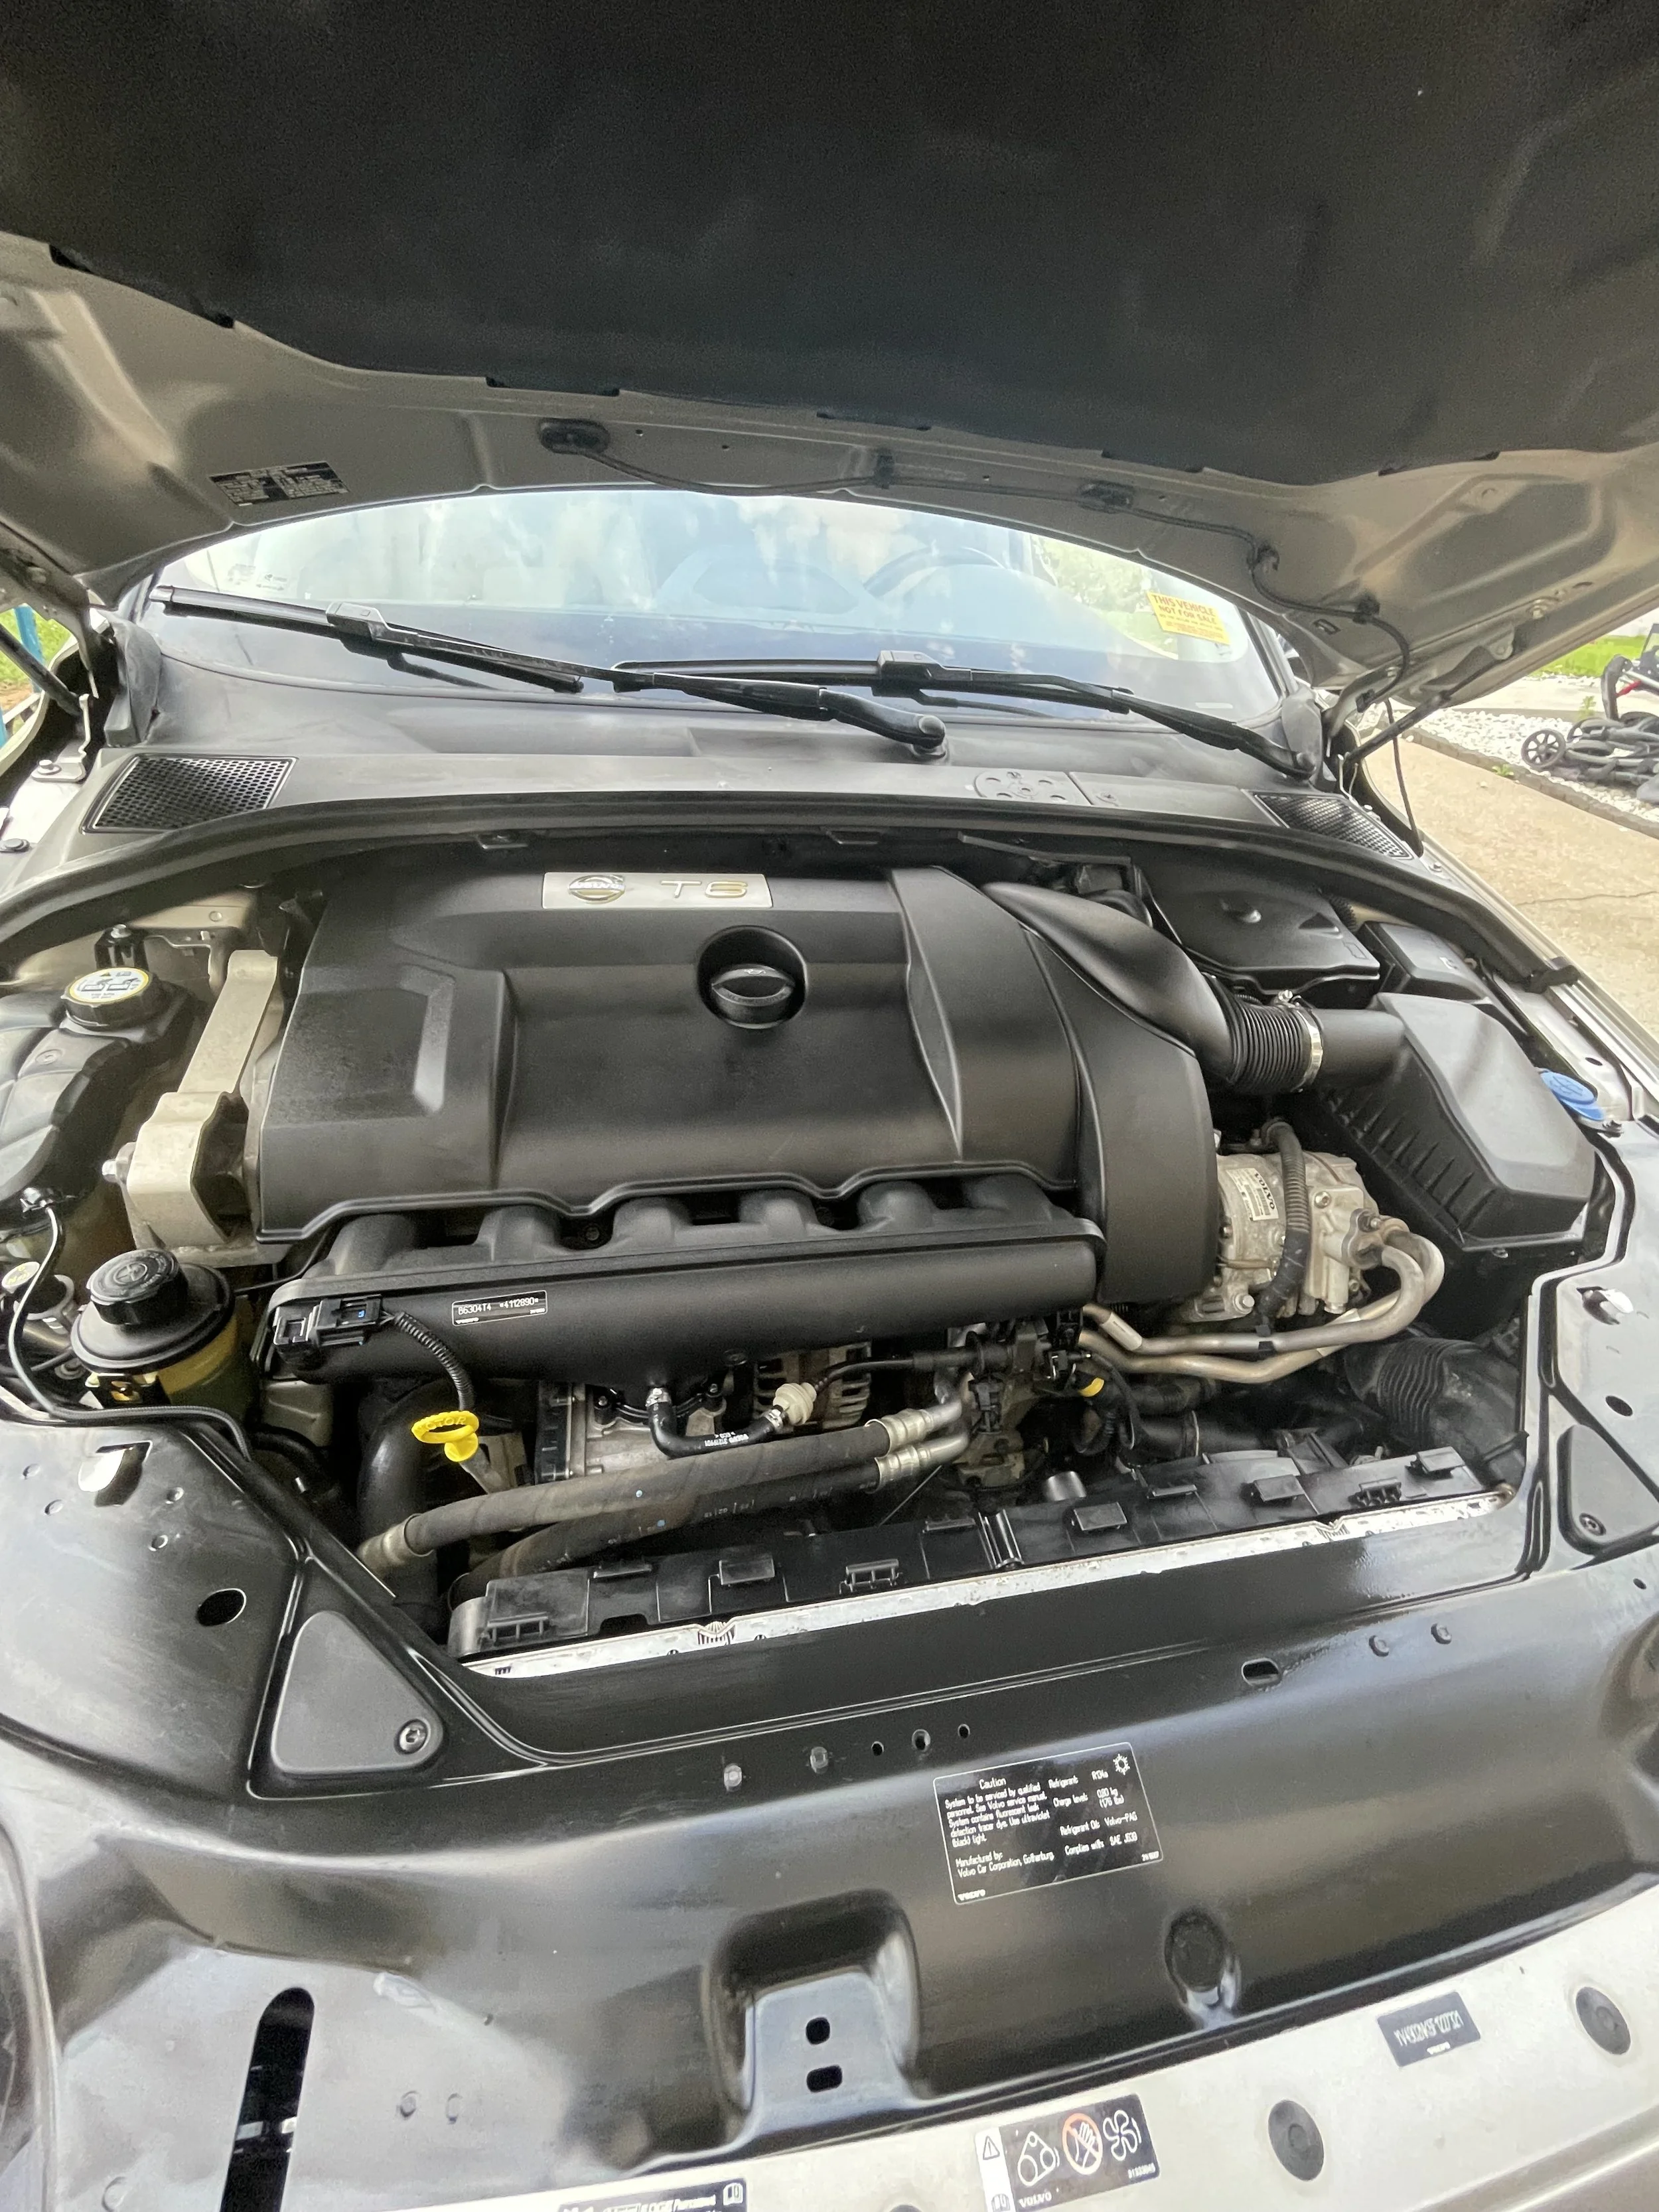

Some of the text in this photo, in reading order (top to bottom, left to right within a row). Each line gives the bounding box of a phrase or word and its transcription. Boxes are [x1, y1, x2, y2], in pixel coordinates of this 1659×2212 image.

[1151, 595, 1216, 617] THIS VEHICLE
[1159, 605, 1175, 615] NOT
[1178, 609, 1194, 619] FOR
[1197, 614, 1216, 625] SALE
[661, 880, 748, 899] T6
[1255, 1173, 1275, 1210] VOLVO
[979, 1777, 1007, 1790] Caution
[944, 1782, 1041, 1810] System to be serviced by qualified
[975, 1803, 986, 1813] See
[987, 1801, 1005, 1810] Volvo
[1007, 1797, 1026, 1806] service
[1052, 1797, 1072, 1807] Charge
[1110, 1787, 1119, 1797] kg
[948, 1803, 1040, 1828] System contains fluorescent leak
[950, 1826, 976, 1838] detection
[978, 1823, 994, 1832] tracer
[1009, 1816, 1020, 1826] Use
[1021, 1809, 1050, 1824] ultraviolet
[1060, 1822, 1090, 1836] Refrigerant
[1104, 1811, 1138, 1826] Volvo-PAG
[1064, 1842, 1090, 1856] Complies
[1110, 1834, 1122, 1846] SAE
[956, 1852, 993, 1868] Manufactured
[958, 1868, 976, 1878] Volvo
[977, 1864, 987, 1874] Car
[1019, 2191, 1052, 2208] VOLVO
